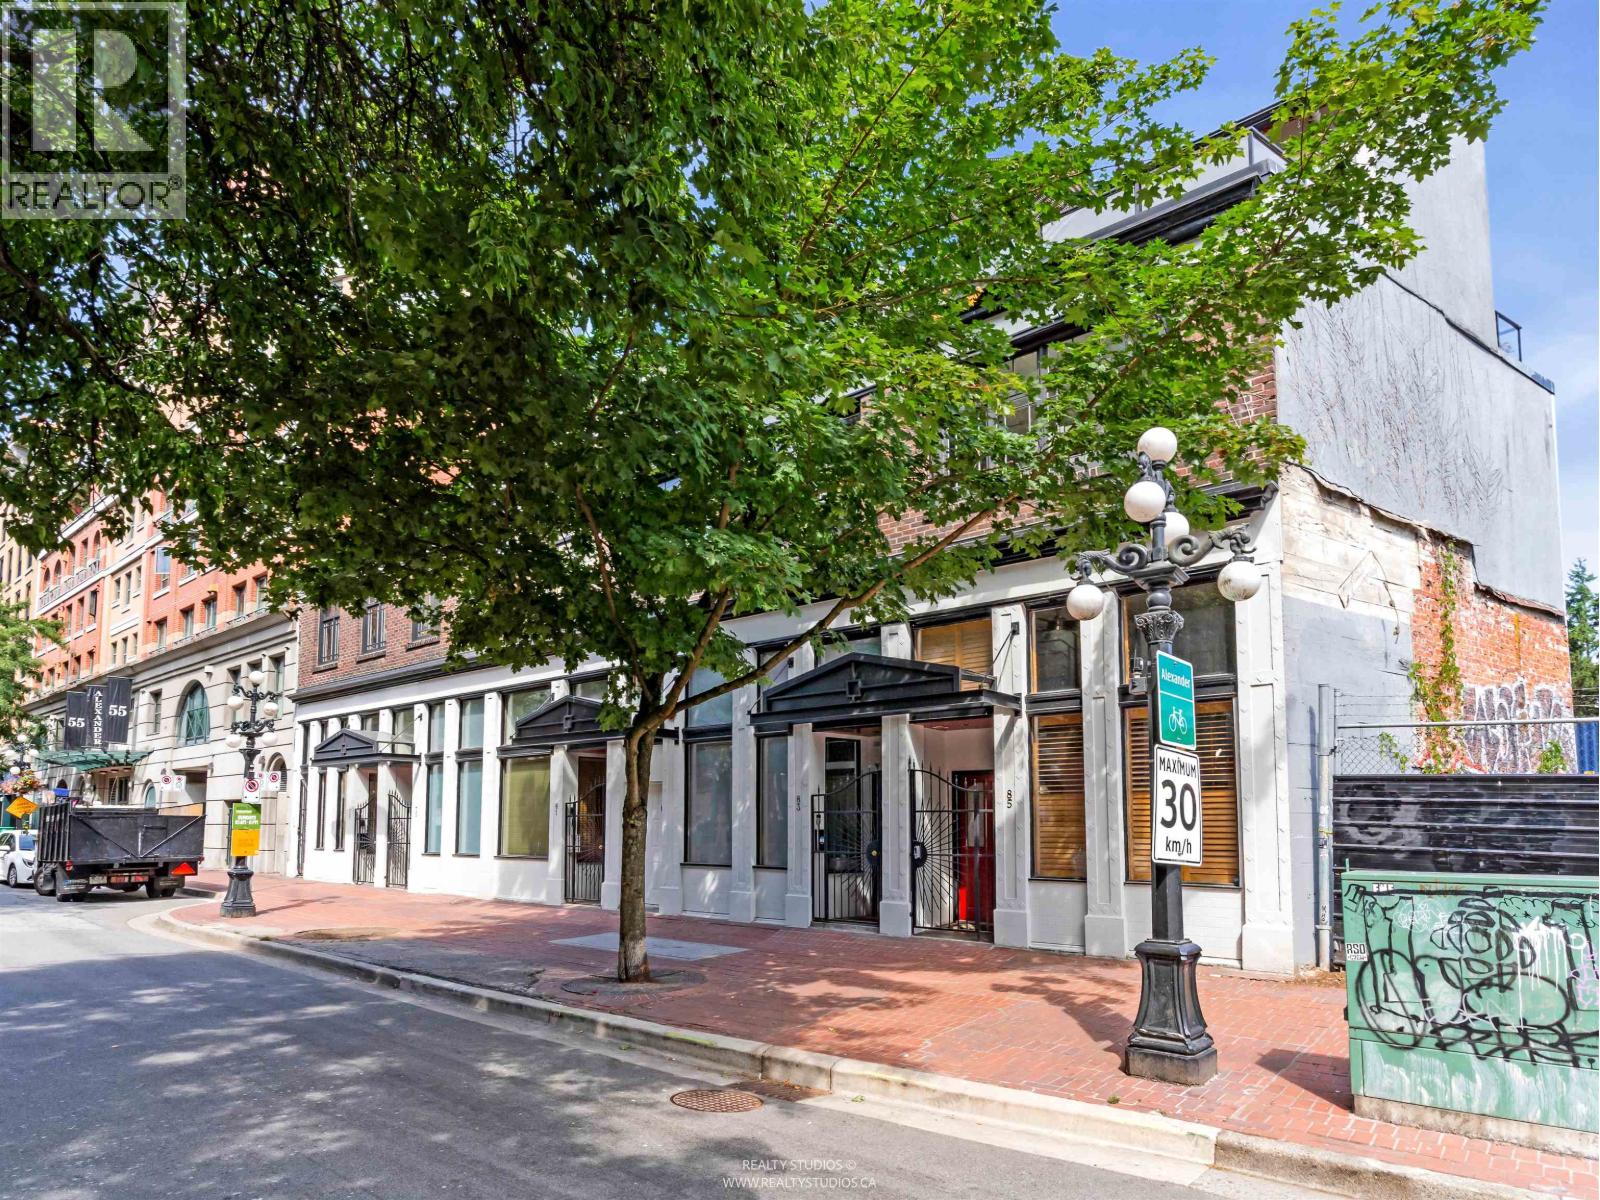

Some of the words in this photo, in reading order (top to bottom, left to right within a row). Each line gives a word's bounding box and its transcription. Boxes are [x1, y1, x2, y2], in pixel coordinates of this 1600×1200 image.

[1161, 667, 1191, 688] Alexander
[93, 690, 103, 744] ALEXANDER
[109, 705, 127, 716] 55
[68, 717, 85, 727] 55
[1159, 755, 1197, 779] MAXIMUM
[1006, 789, 1013, 809] 85
[1160, 779, 1197, 831] 30
[1165, 836, 1192, 854] km/h
